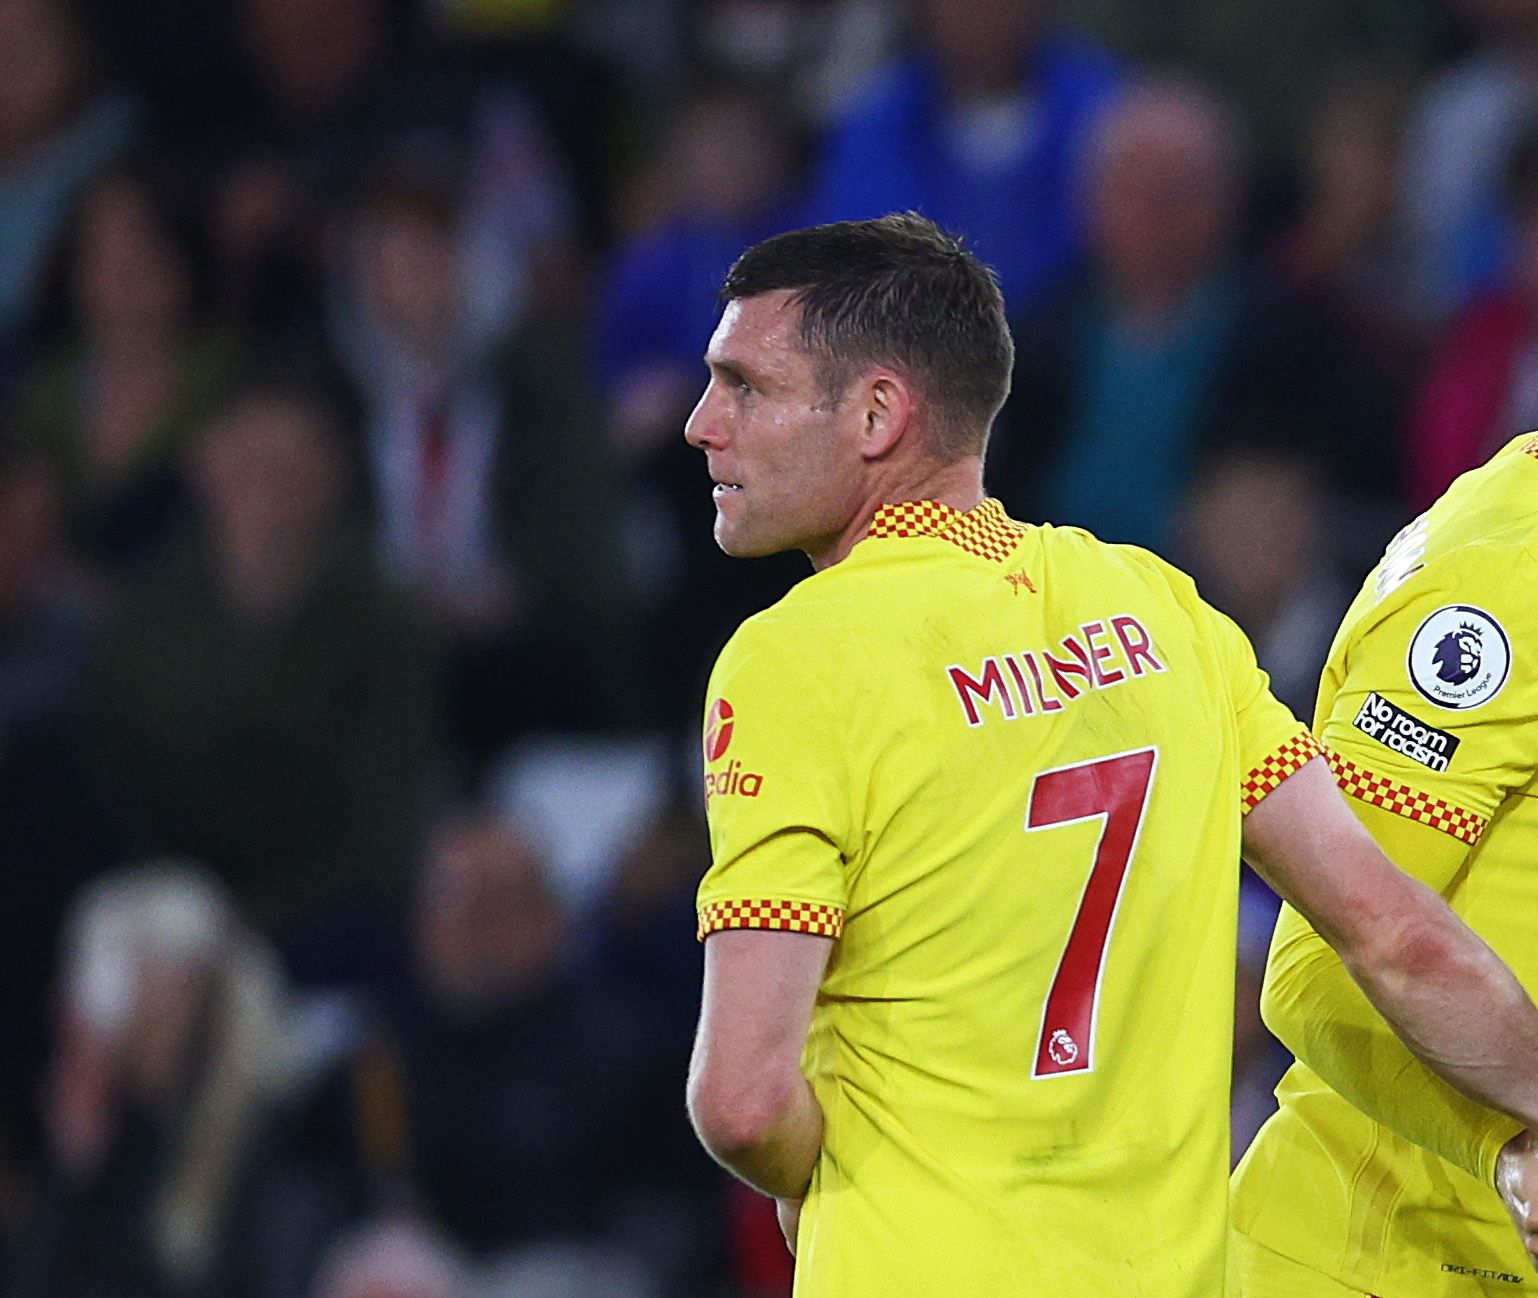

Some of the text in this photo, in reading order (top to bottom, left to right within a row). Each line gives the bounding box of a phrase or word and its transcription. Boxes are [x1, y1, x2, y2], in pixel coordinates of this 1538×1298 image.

[946, 613, 1168, 728] MILNER
[1433, 671, 1493, 700] Premier League
[1353, 709, 1449, 773] for racism
[1364, 692, 1448, 753] No room
[1024, 745, 1160, 1081] 7
